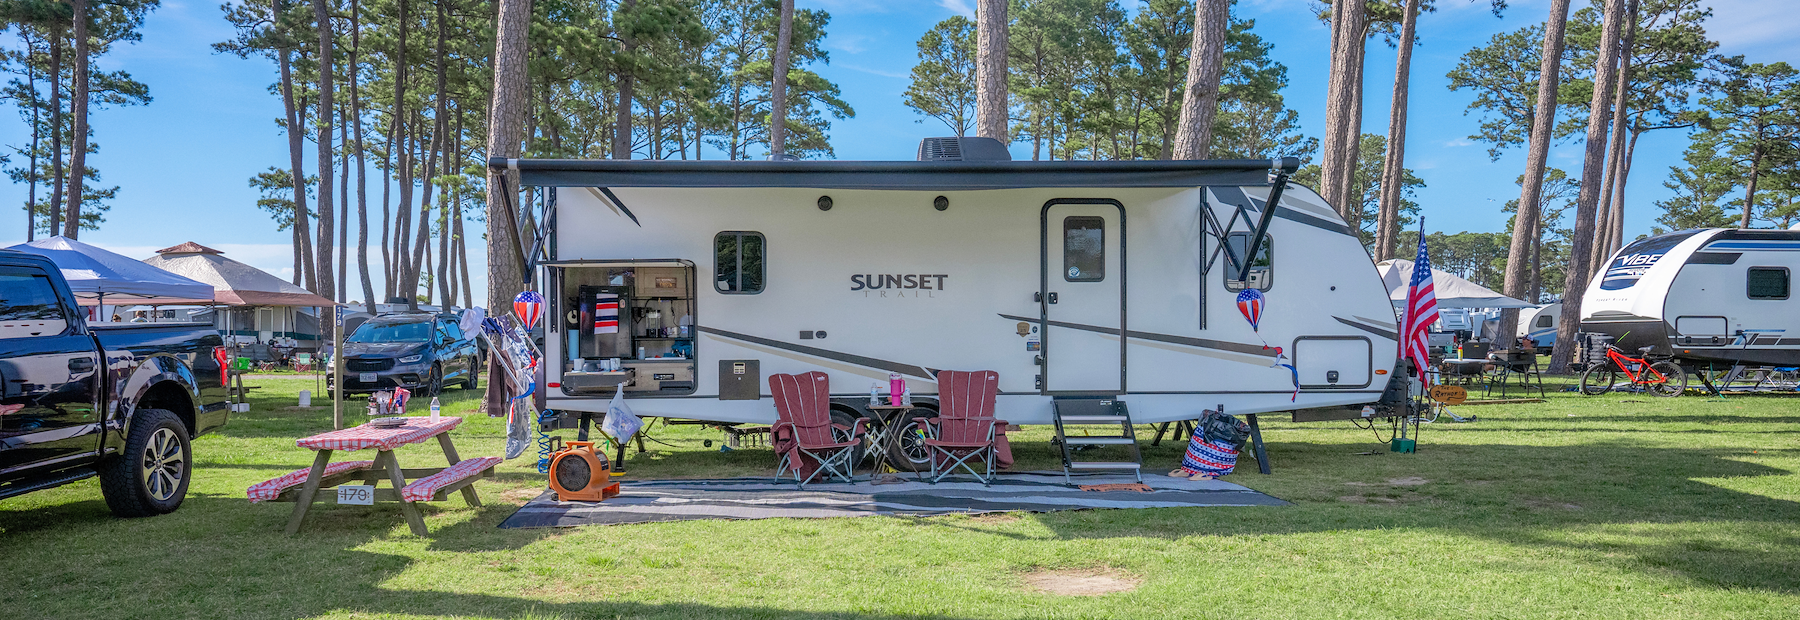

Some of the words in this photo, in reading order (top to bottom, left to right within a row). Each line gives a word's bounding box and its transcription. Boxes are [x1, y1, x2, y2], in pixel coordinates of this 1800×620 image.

[1615, 253, 1664, 267] VIBE
[850, 273, 949, 291] SUNSET
[863, 290, 935, 298] TRAIL
